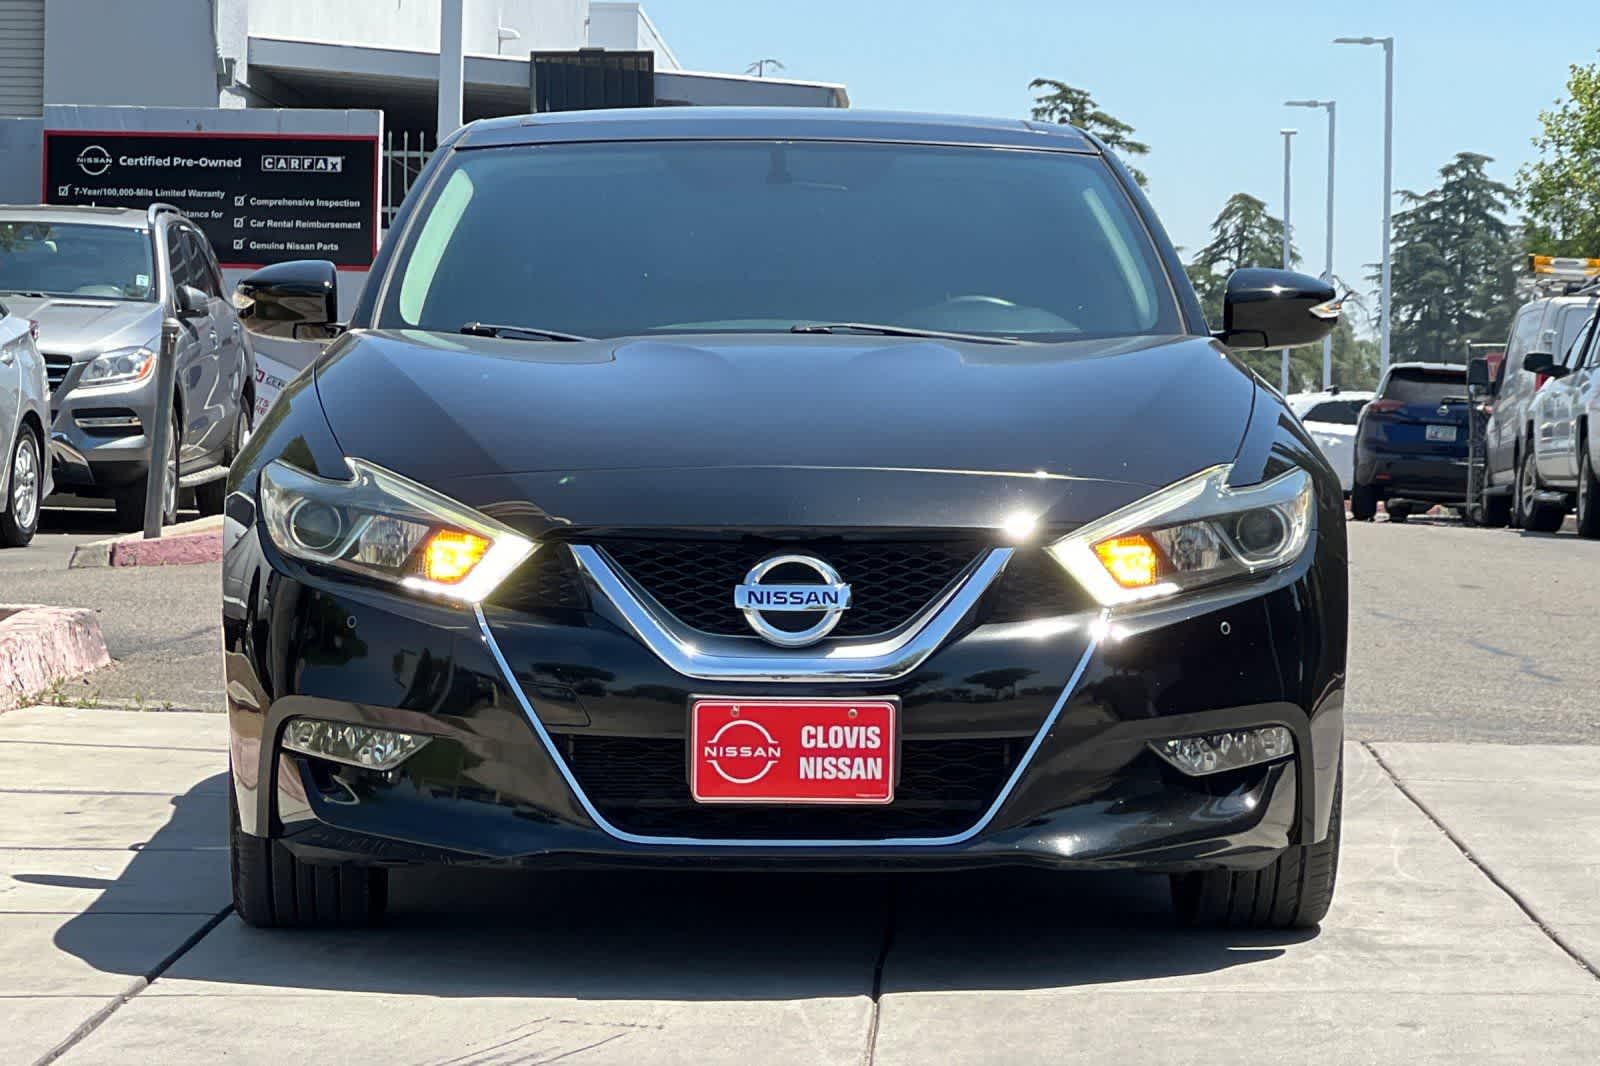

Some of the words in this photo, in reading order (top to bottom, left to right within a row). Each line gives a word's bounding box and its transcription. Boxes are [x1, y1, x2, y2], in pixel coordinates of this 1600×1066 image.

[119, 155, 170, 166] Certified
[173, 156, 242, 167] Pre-Owned
[264, 157, 340, 171] CARFAX
[74, 187, 152, 197] 7-Year/100,000-Mile
[155, 188, 187, 197] Limited
[188, 189, 225, 199] Warranty
[249, 197, 315, 207] Comprehensive
[317, 198, 360, 208] Inspection
[211, 209, 224, 218] for
[250, 219, 265, 227] Car
[267, 219, 293, 228] Rental
[295, 220, 361, 229] Reimbursement
[249, 241, 285, 250] Genuine
[287, 241, 315, 250] Nissan
[317, 242, 339, 251] Parts
[747, 590, 839, 605] NISSAN
[801, 725, 881, 749] CLOVIS
[704, 746, 781, 758] NISSAN
[799, 757, 882, 780] NISSAN
